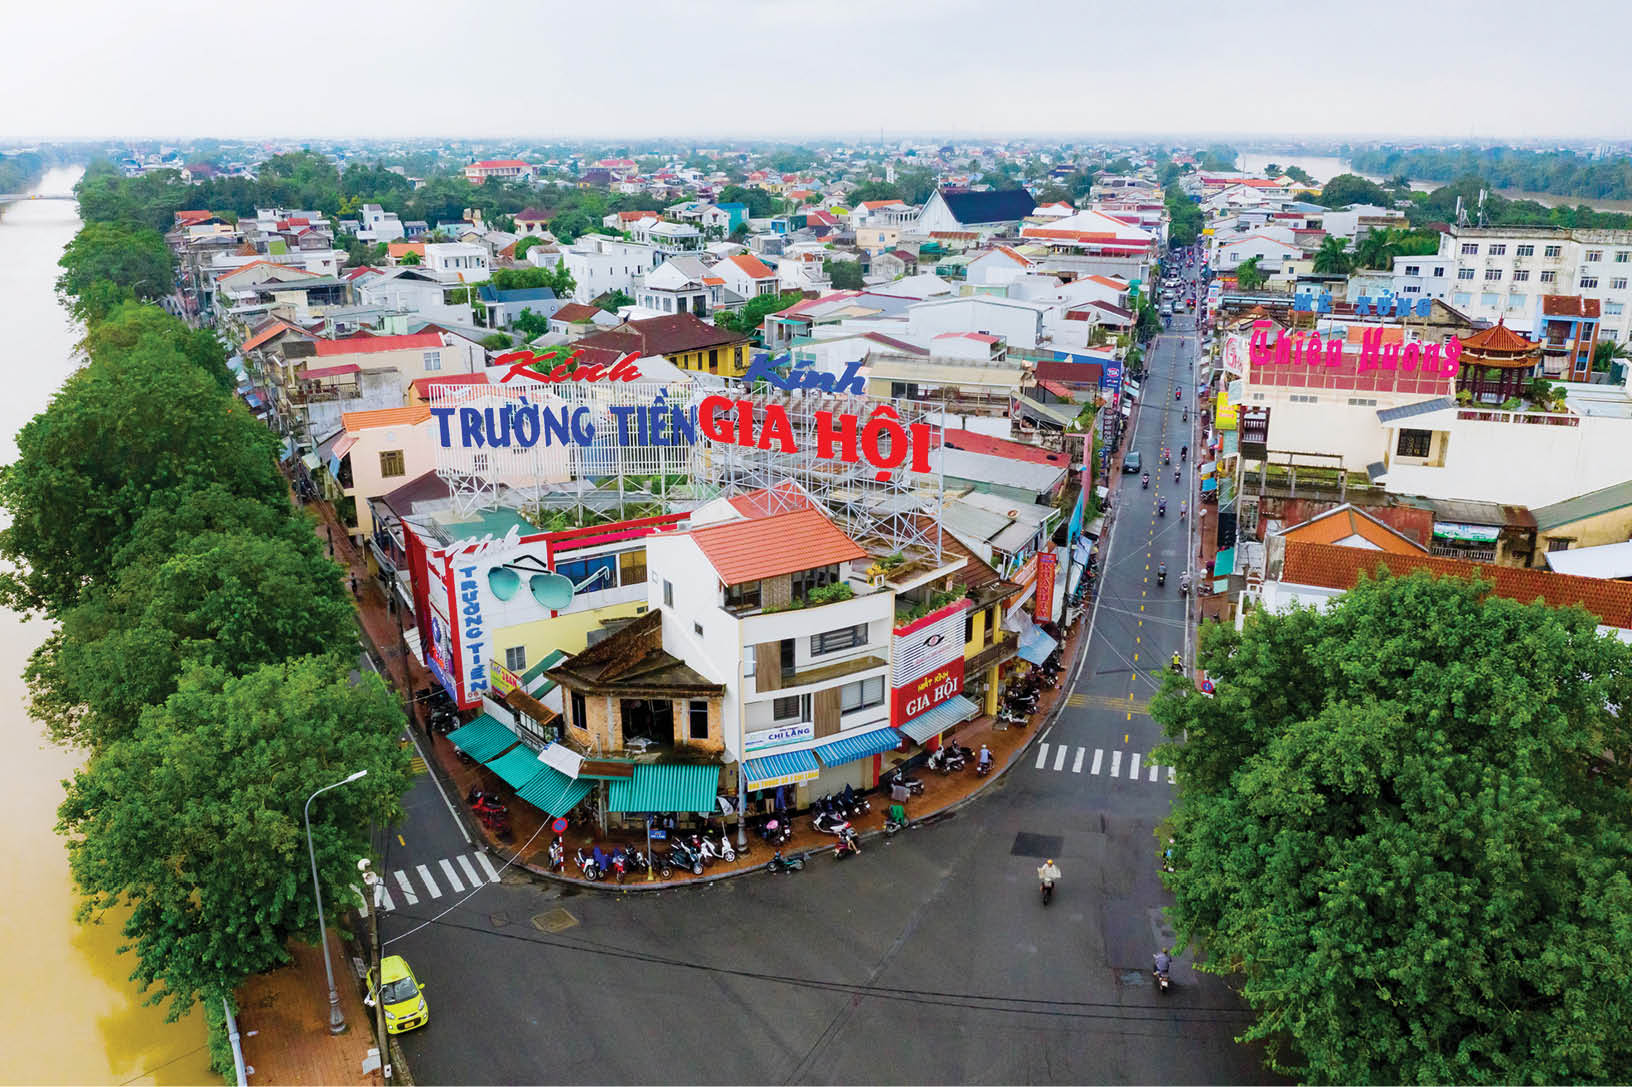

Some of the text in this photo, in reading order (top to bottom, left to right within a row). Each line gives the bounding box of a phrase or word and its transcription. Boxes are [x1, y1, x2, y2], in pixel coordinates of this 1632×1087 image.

[495, 349, 642, 384] Kính
[1249, 320, 1343, 367] Thiên
[1358, 327, 1463, 378] Hương
[741, 353, 867, 395] Kính
[430, 388, 698, 449] TRƯỜNG TIỀN
[699, 395, 932, 482] GIA HỘI
[906, 677, 959, 716] GIA HỘI
[768, 732, 783, 740] CHI
[785, 727, 810, 738] LĂNG
